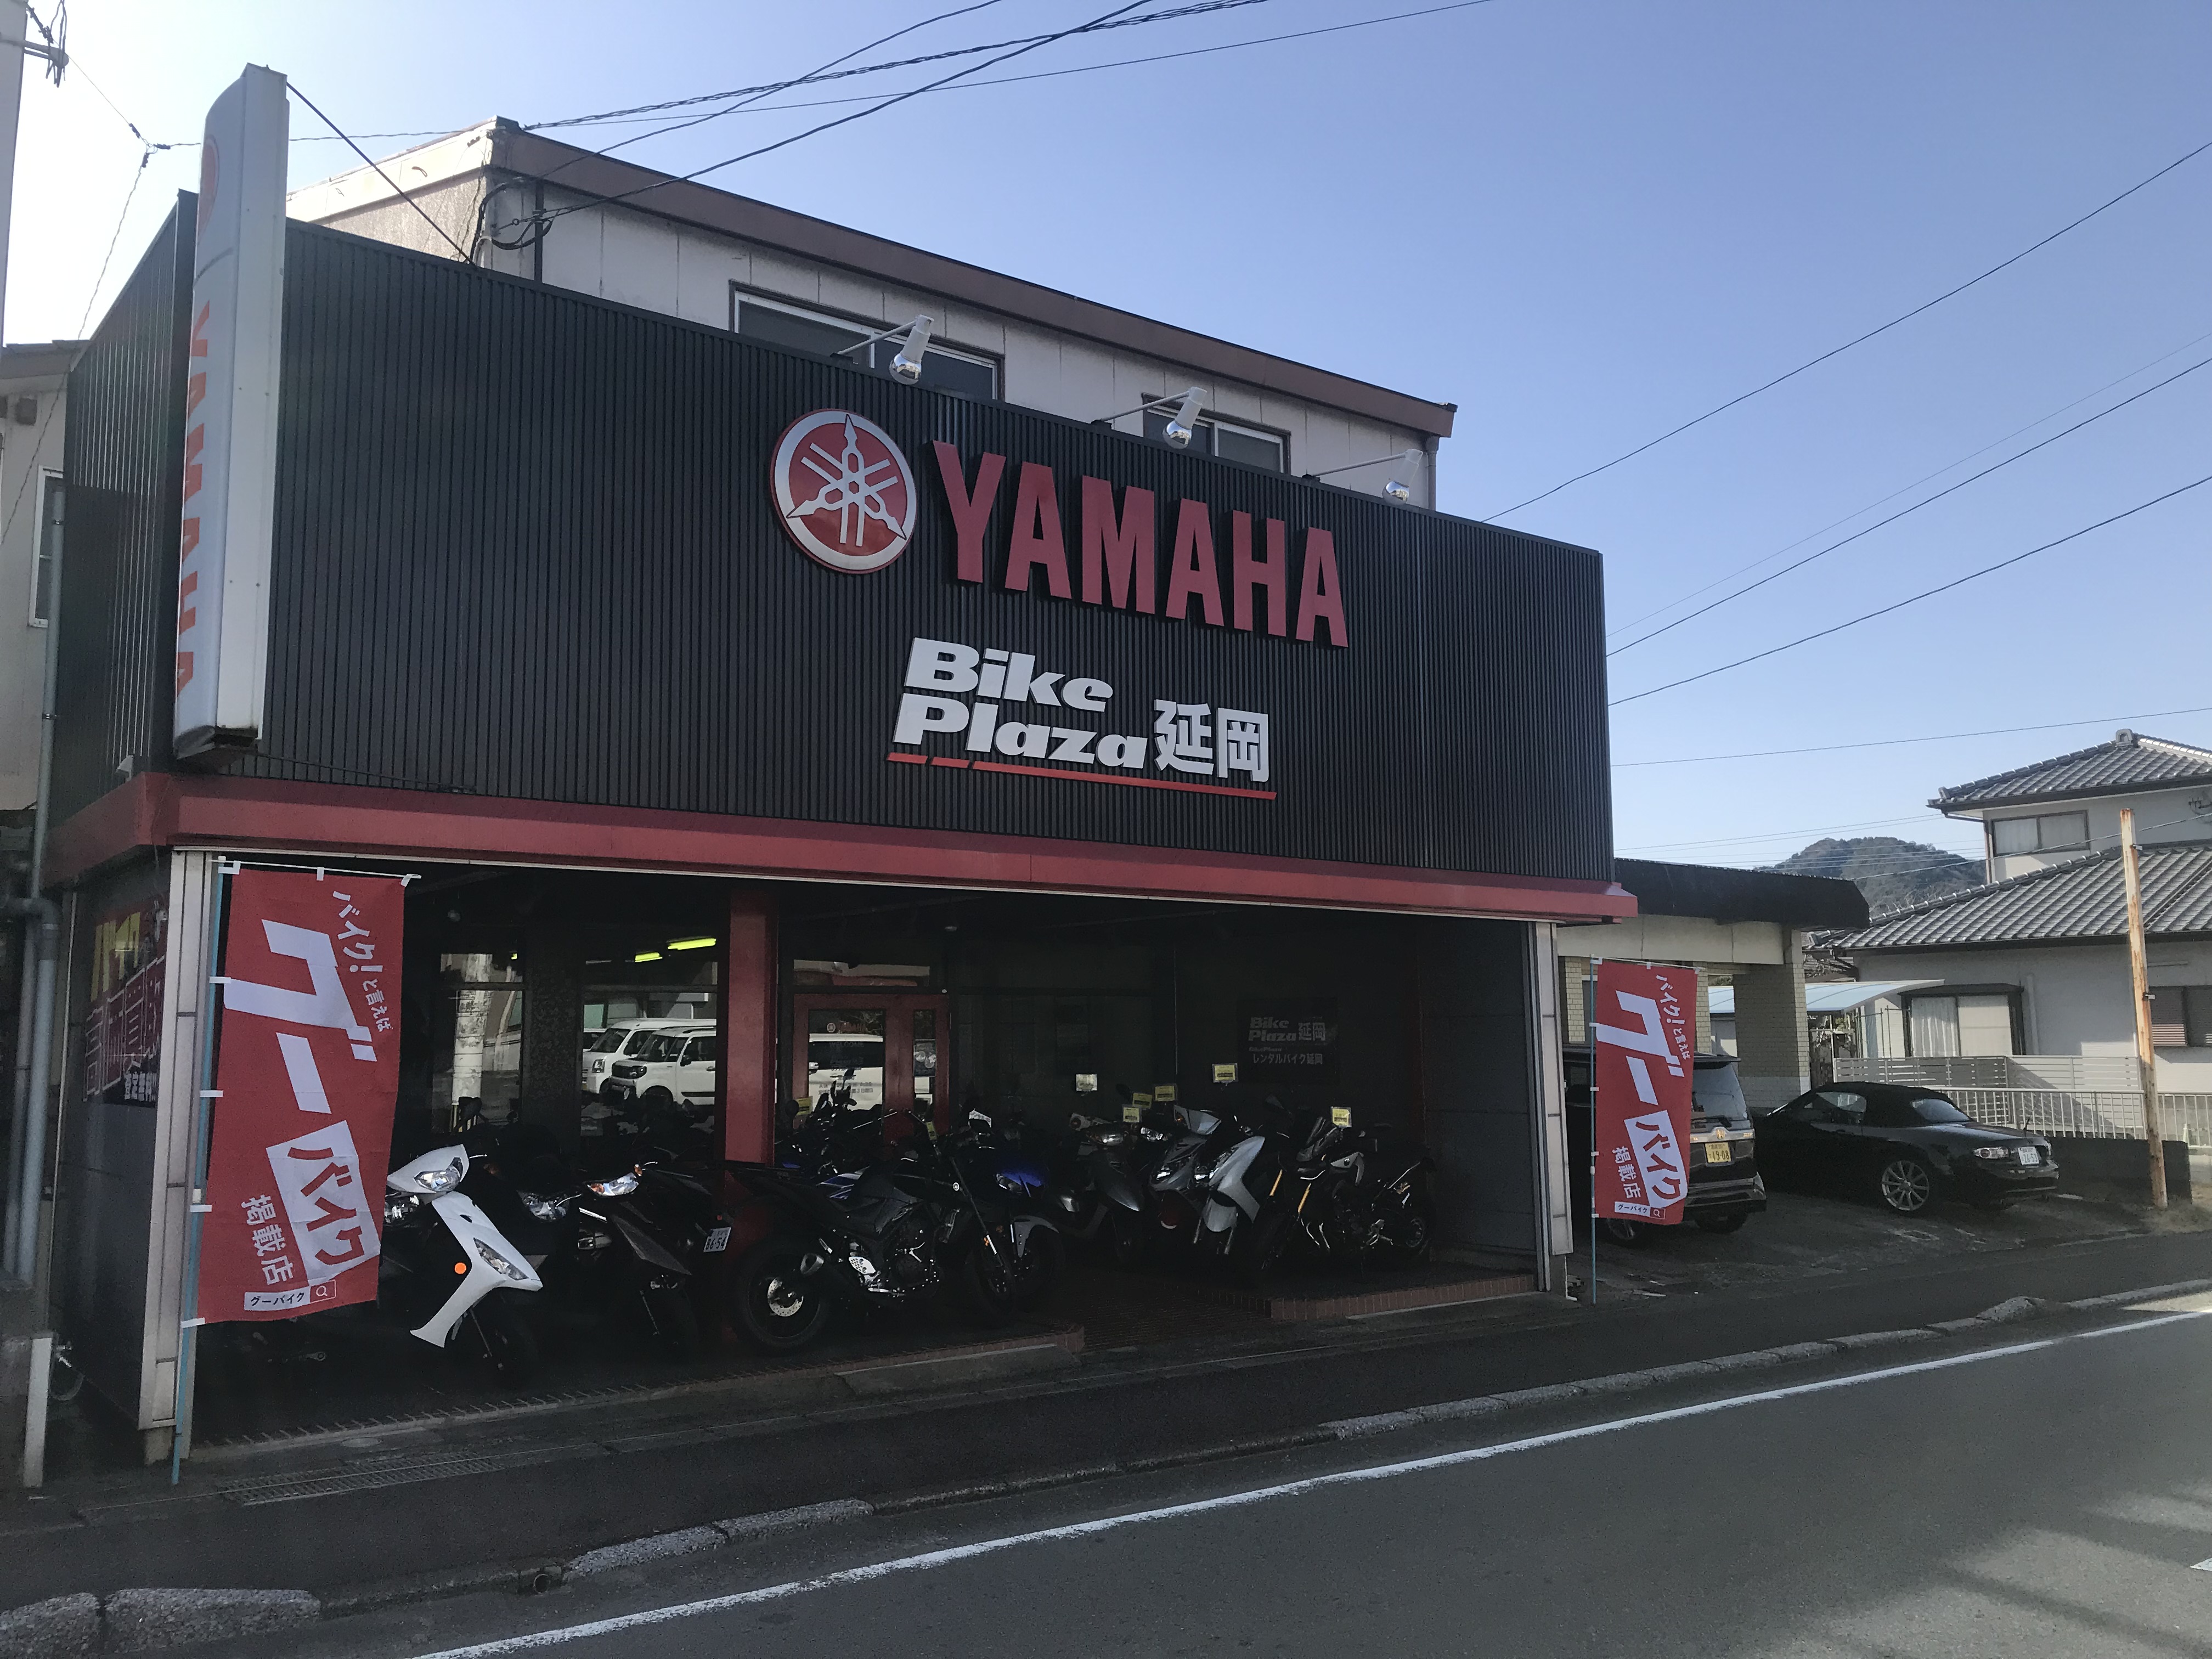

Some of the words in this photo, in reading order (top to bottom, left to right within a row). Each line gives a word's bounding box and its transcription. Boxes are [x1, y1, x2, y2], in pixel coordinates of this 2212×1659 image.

[932, 439, 1348, 647] YAMAHA
[904, 636, 1113, 712] Bike
[893, 692, 1148, 769] Plaza
[1154, 699, 1269, 782] 延岡
[1248, 1030, 1296, 1041] Plaza
[1299, 1022, 1325, 1041] 延岡
[1250, 1017, 1289, 1028] Bike
[1253, 1053, 1323, 1065] レンタルバイク延岡
[1612, 1146, 1641, 1199] 掲載店
[1618, 1204, 1647, 1213] グーバイク
[241, 1194, 293, 1285] 掲載店
[251, 1293, 304, 1306] グーバイク
